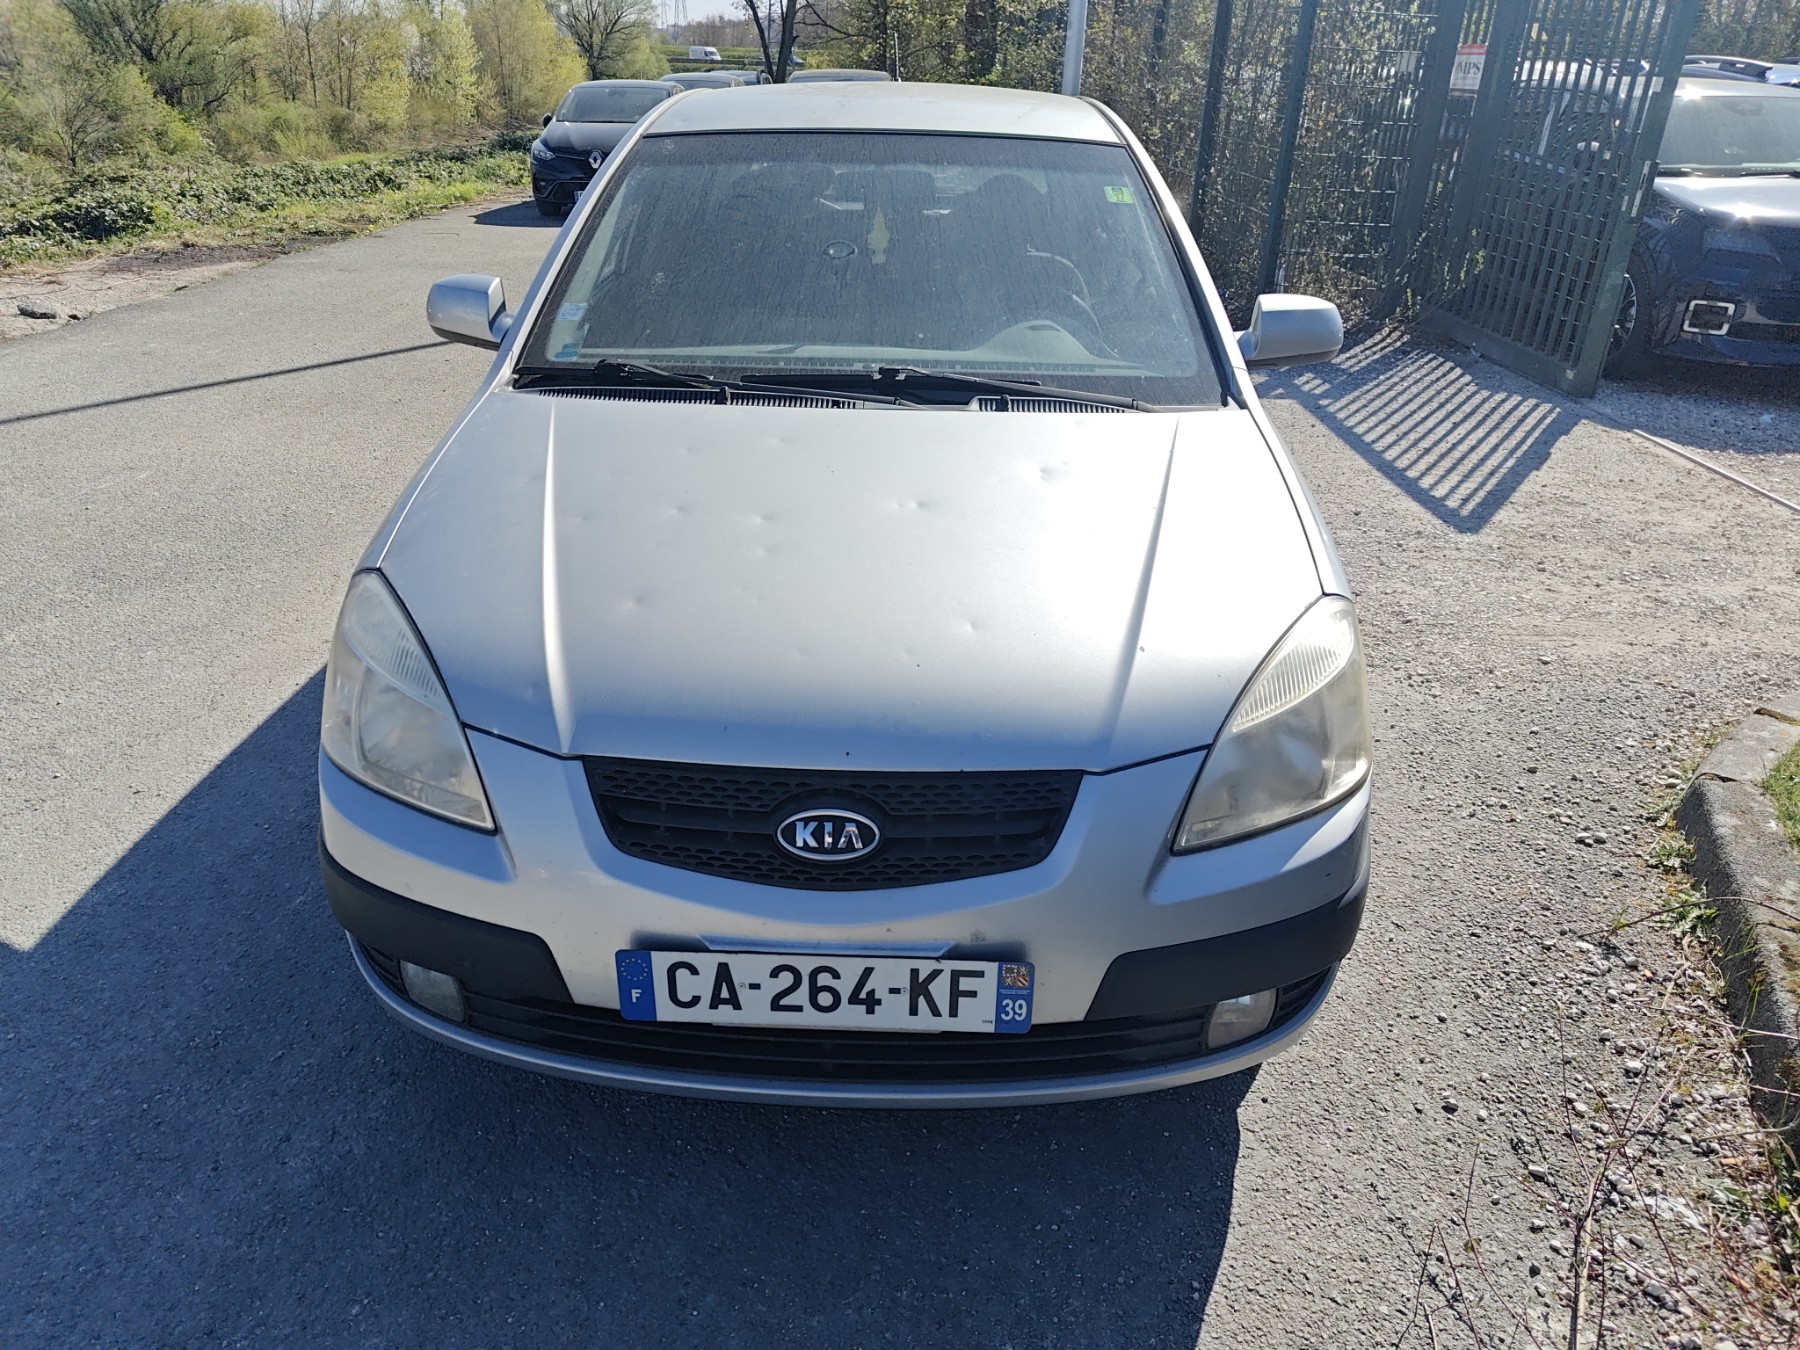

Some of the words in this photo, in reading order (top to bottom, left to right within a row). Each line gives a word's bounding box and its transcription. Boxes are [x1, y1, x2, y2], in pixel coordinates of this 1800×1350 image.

[795, 821, 863, 849] KIA
[631, 989, 642, 1003] F
[666, 960, 985, 1018] CA-264-KF
[1000, 998, 1028, 1021] 39
